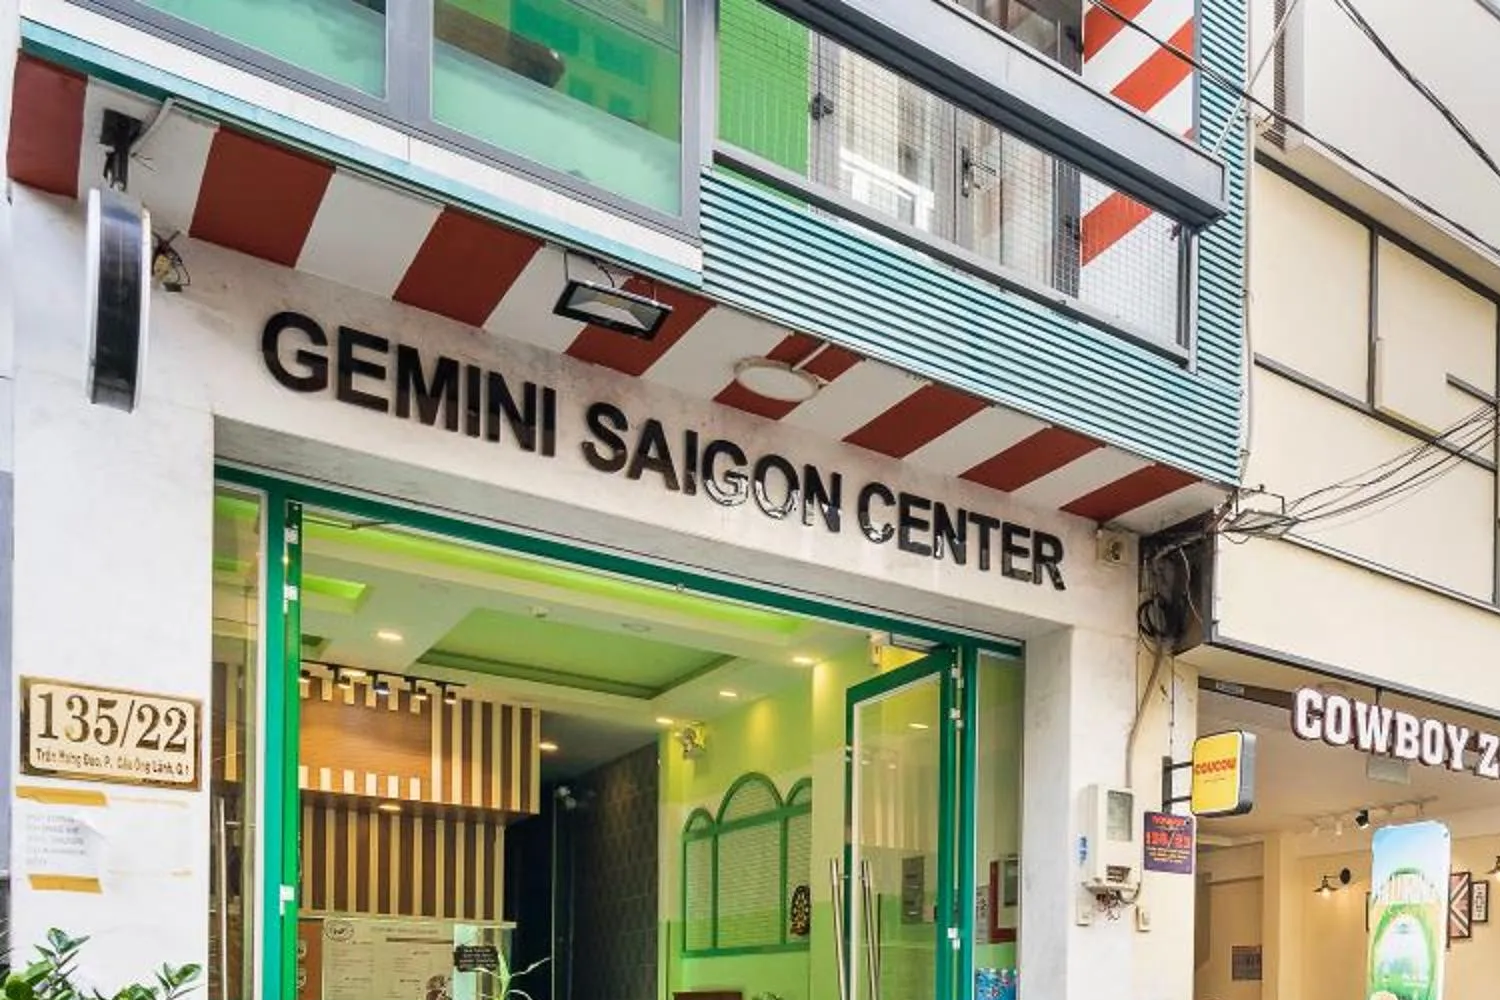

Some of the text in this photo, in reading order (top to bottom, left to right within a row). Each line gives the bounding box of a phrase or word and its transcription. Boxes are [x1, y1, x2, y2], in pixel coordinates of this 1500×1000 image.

[261, 311, 1066, 591] GEMINI SAIGON CENTER
[37, 691, 188, 754] 135/22
[1293, 687, 1469, 772] COWBOY
